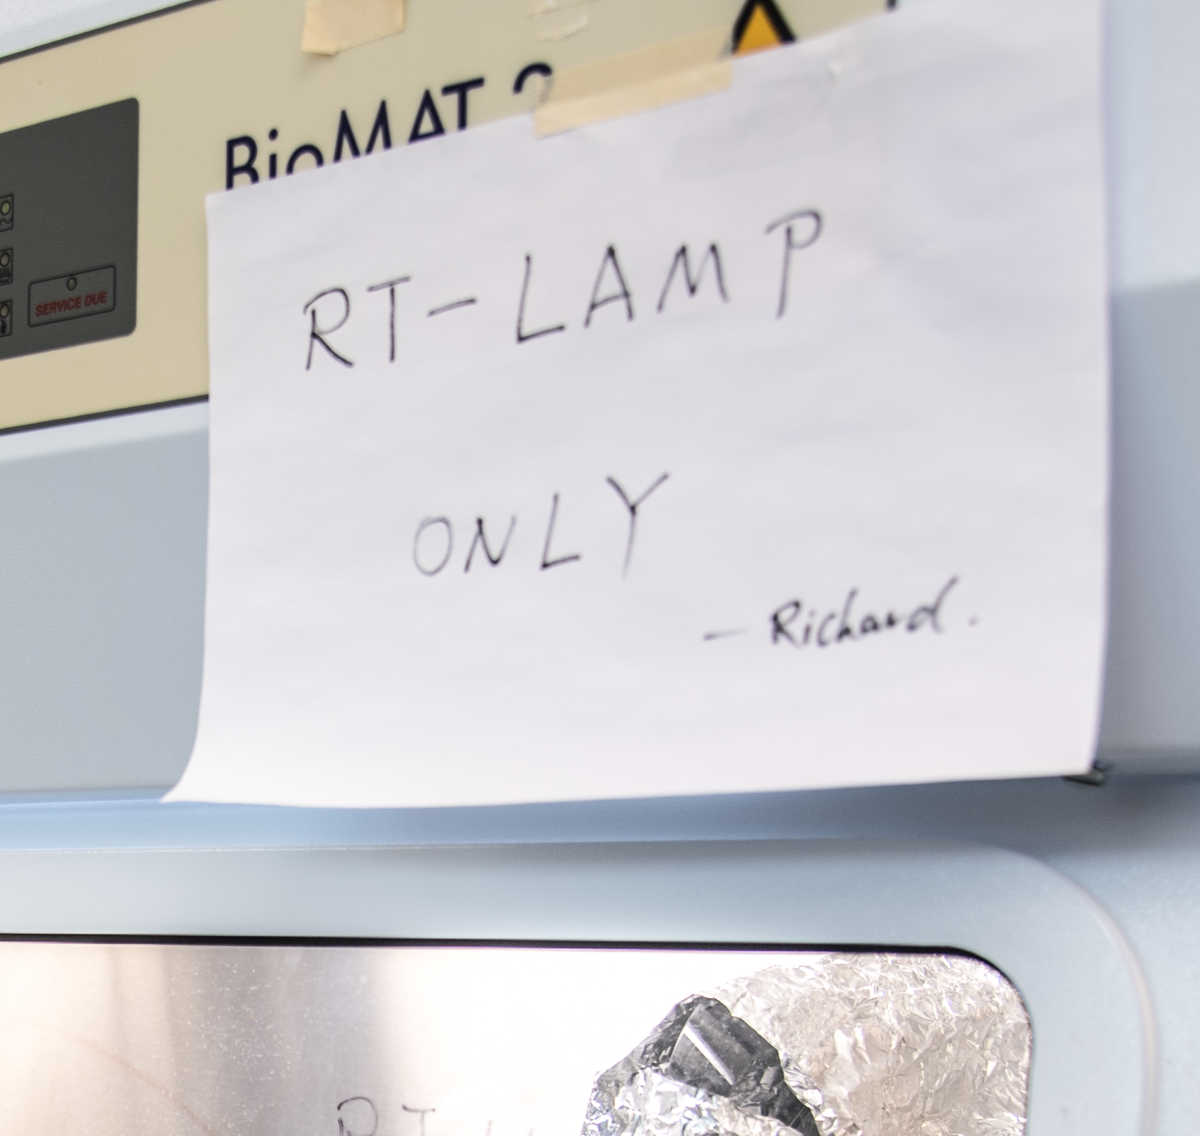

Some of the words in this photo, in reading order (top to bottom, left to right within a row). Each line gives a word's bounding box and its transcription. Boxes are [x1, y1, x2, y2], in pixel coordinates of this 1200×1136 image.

[35, 296, 82, 317] SERVICE
[84, 290, 108, 307] DUE
[303, 208, 824, 371] RT-LAMP
[413, 473, 669, 581] ONLY
